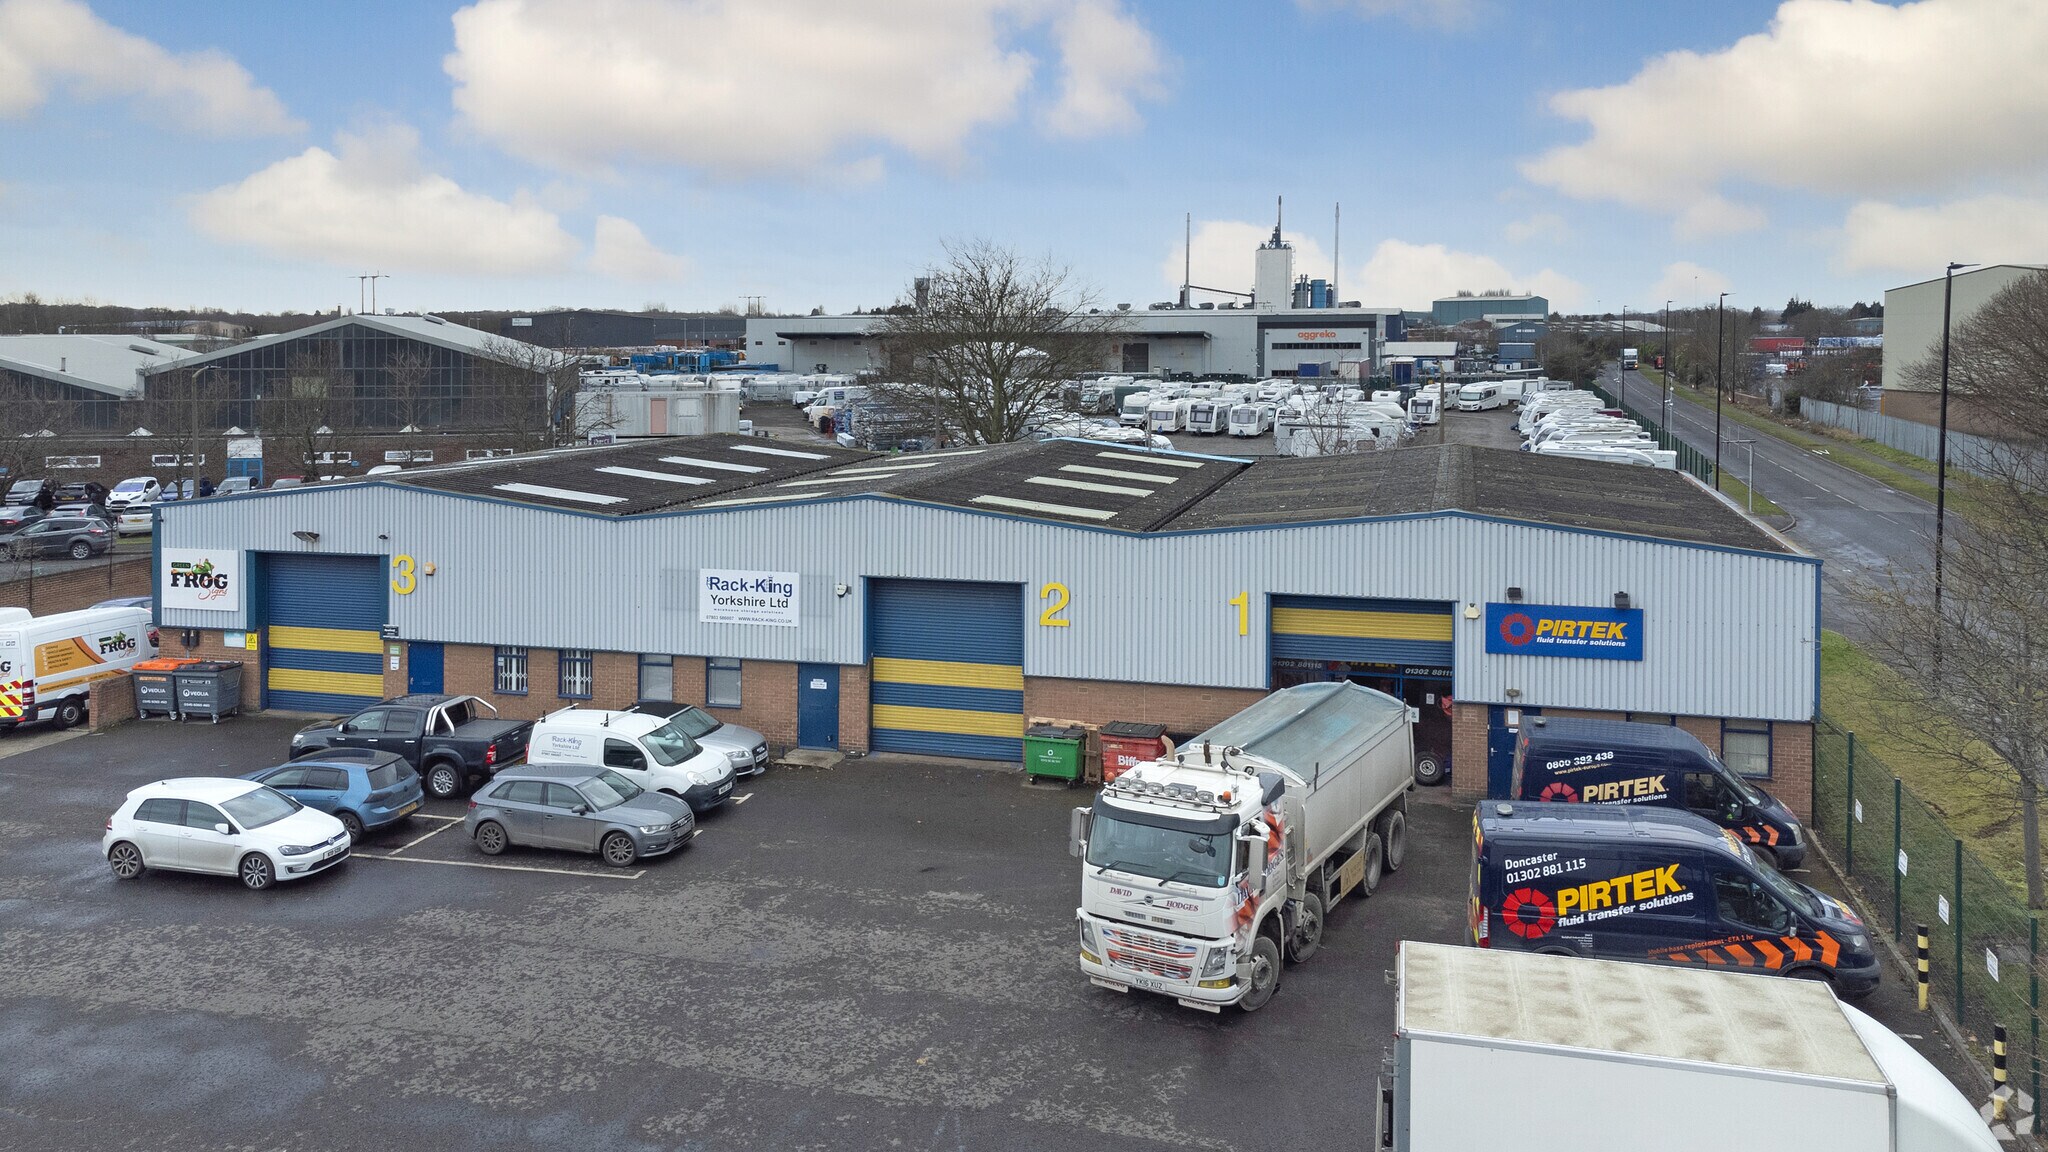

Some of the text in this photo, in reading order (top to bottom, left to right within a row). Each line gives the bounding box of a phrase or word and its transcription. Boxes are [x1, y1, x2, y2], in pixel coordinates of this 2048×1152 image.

[1298, 330, 1336, 340] aggreko
[171, 572, 228, 589] FROG
[392, 554, 416, 595] 3
[707, 575, 793, 598] Rack-King
[711, 594, 789, 609] Yorkshire Ltd
[1039, 582, 1070, 627] 2
[1229, 591, 1248, 636] 1
[1536, 619, 1628, 640] PIRTEK
[100, 638, 136, 655] FROG
[1536, 636, 1626, 647] fluid transfer solutions
[1405, 667, 1430, 675] 01302
[148, 686, 166, 694] VEOLIA
[190, 689, 210, 697] VEOLIA
[1546, 751, 1614, 770] 0800 382 438
[1583, 775, 1667, 803] PIRTEK
[1633, 793, 1668, 804] solutions
[1505, 852, 1558, 870] Doncaster
[1506, 857, 1587, 884] 01302 881 115
[1109, 886, 1133, 897] DAVID
[1557, 863, 1688, 917] PIRTEK
[1166, 900, 1199, 912] HODGES
[1557, 892, 1694, 927] fluid transfer solutions
[1684, 938, 1724, 950] replacement
[1150, 980, 1163, 989] XUZ
